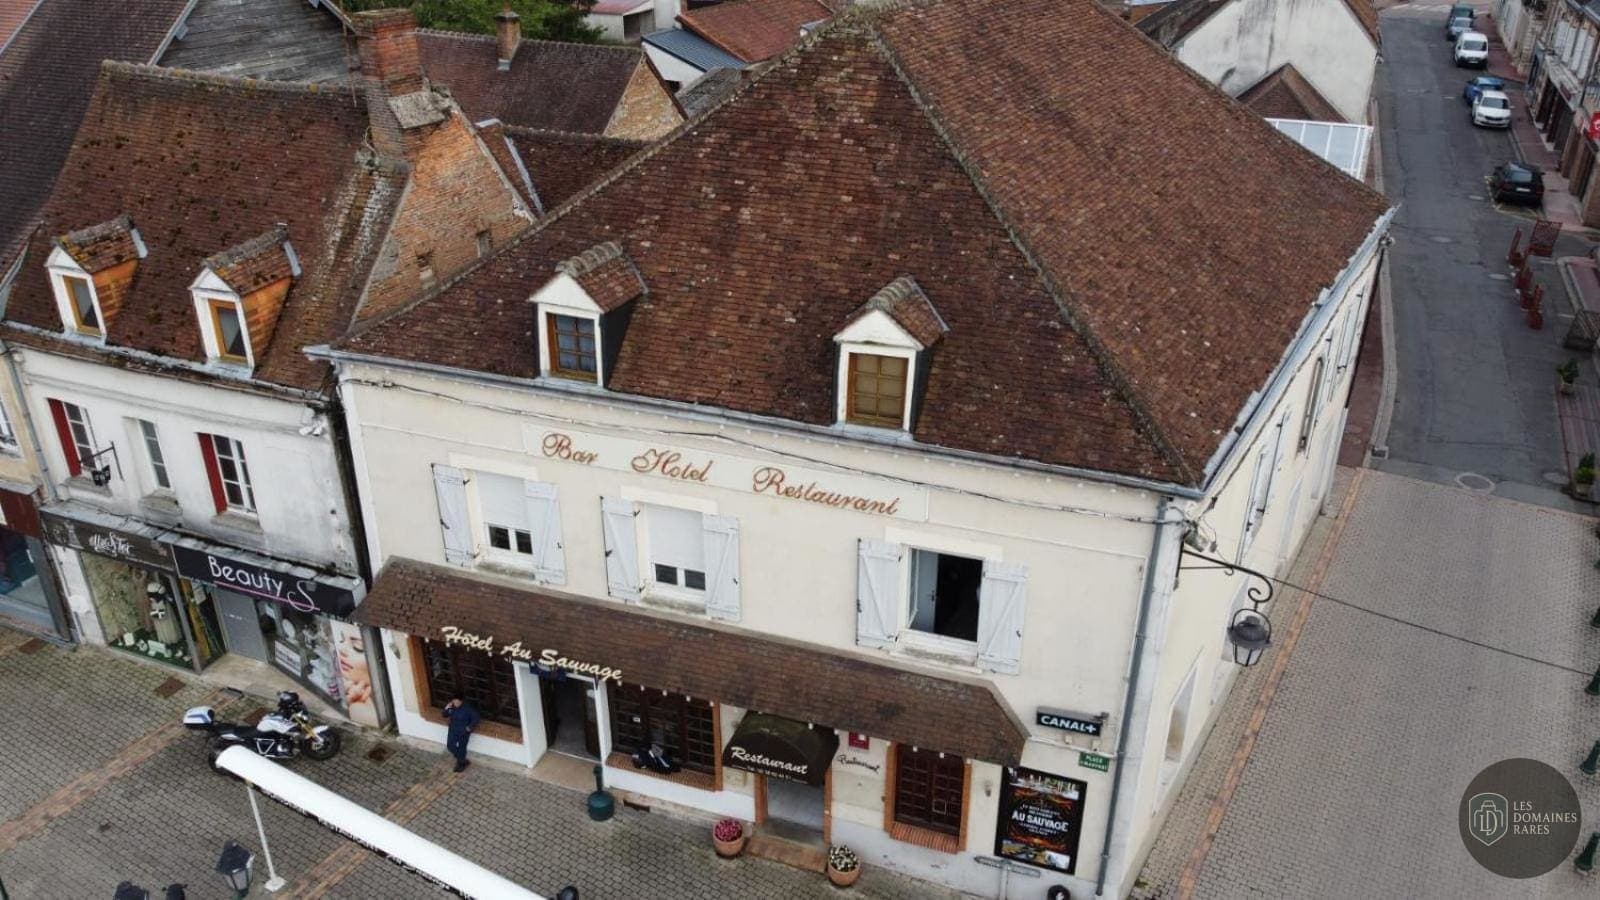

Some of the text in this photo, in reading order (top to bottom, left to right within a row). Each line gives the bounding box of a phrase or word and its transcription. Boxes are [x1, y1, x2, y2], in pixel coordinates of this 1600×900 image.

[542, 433, 598, 466] Bar
[752, 466, 900, 516] Restaurant
[208, 555, 315, 612] Beauty S
[442, 626, 623, 681] Hôtel Au Sauvage
[1041, 715, 1097, 733] CANAL+
[730, 746, 809, 775] Restaurant
[1012, 810, 1026, 821] AU
[1027, 814, 1070, 832] SAUVAGE
